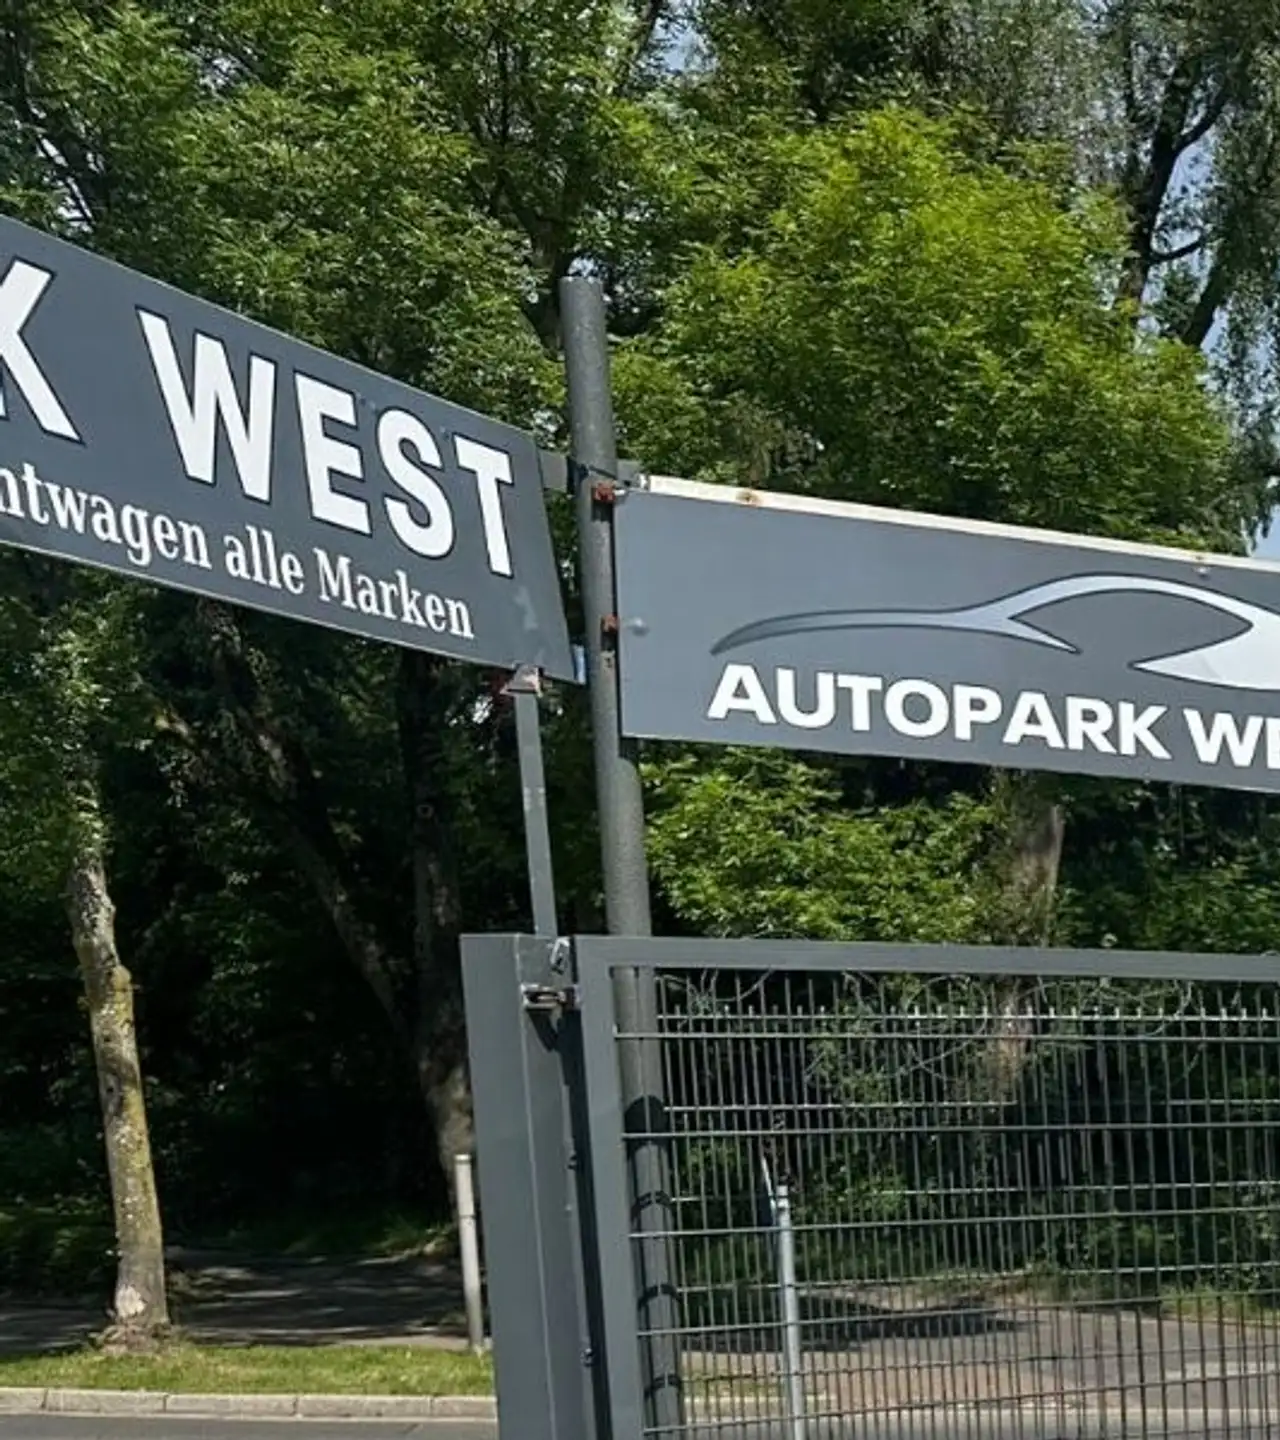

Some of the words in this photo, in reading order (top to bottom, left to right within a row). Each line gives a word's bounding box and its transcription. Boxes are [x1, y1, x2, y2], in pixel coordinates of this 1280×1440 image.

[137, 308, 513, 577] WEST
[223, 524, 306, 596] alle
[313, 547, 475, 641] Marken
[707, 664, 1172, 760] AUTOPARK
